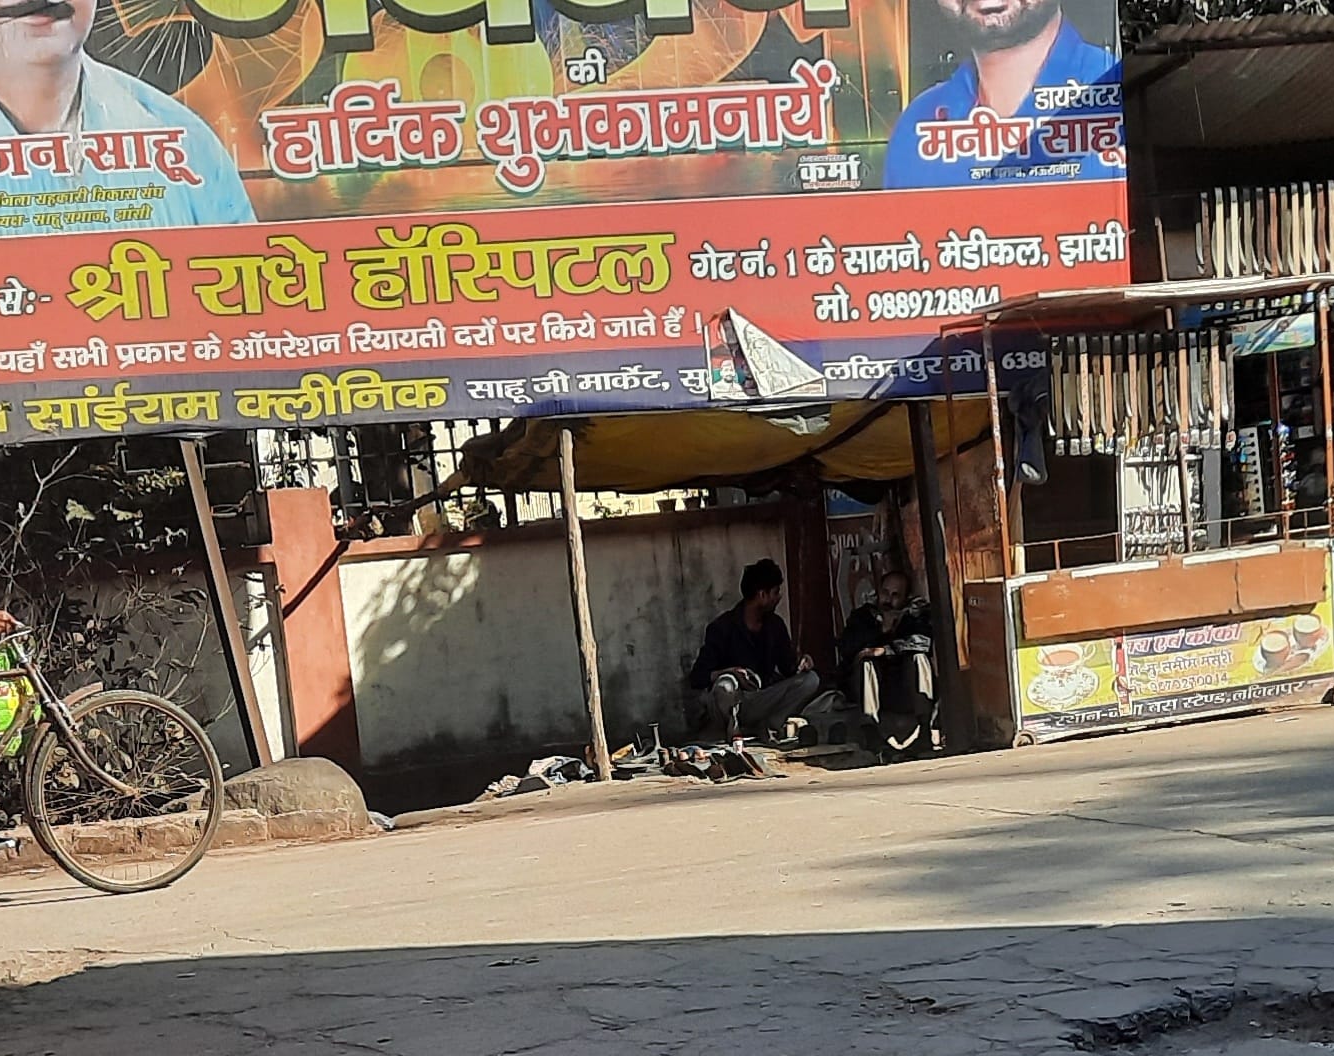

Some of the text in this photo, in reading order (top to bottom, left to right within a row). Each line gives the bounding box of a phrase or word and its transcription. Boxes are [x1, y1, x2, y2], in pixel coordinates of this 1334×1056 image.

[565, 48, 607, 84] की
[1032, 80, 1121, 111] डायरेक्टर
[266, 58, 841, 194] हार्दिक शुभकामनायें
[917, 107, 1128, 167] मनीष साहू
[82, 129, 202, 185] साहू
[67, 223, 676, 322] श्री राधे हॉस्पिटल
[689, 242, 739, 281] गेट
[785, 249, 798, 278] 1
[804, 236, 837, 276] के
[1056, 220, 1127, 266] झांसी
[52, 336, 109, 370] सभी
[114, 337, 187, 371] प्रकार
[192, 332, 223, 362] के
[229, 330, 341, 360] ऑपरेशन
[347, 318, 446, 354] रियायती
[452, 316, 497, 347] दरों
[501, 322, 537, 344] पर
[541, 310, 596, 341] किये
[601, 310, 657, 339] जाते
[660, 304, 686, 339] हैं
[233, 369, 450, 422] क्लीनिक
[466, 377, 534, 403] साहू
[531, 371, 570, 396] जी
[677, 368, 709, 395] सु
